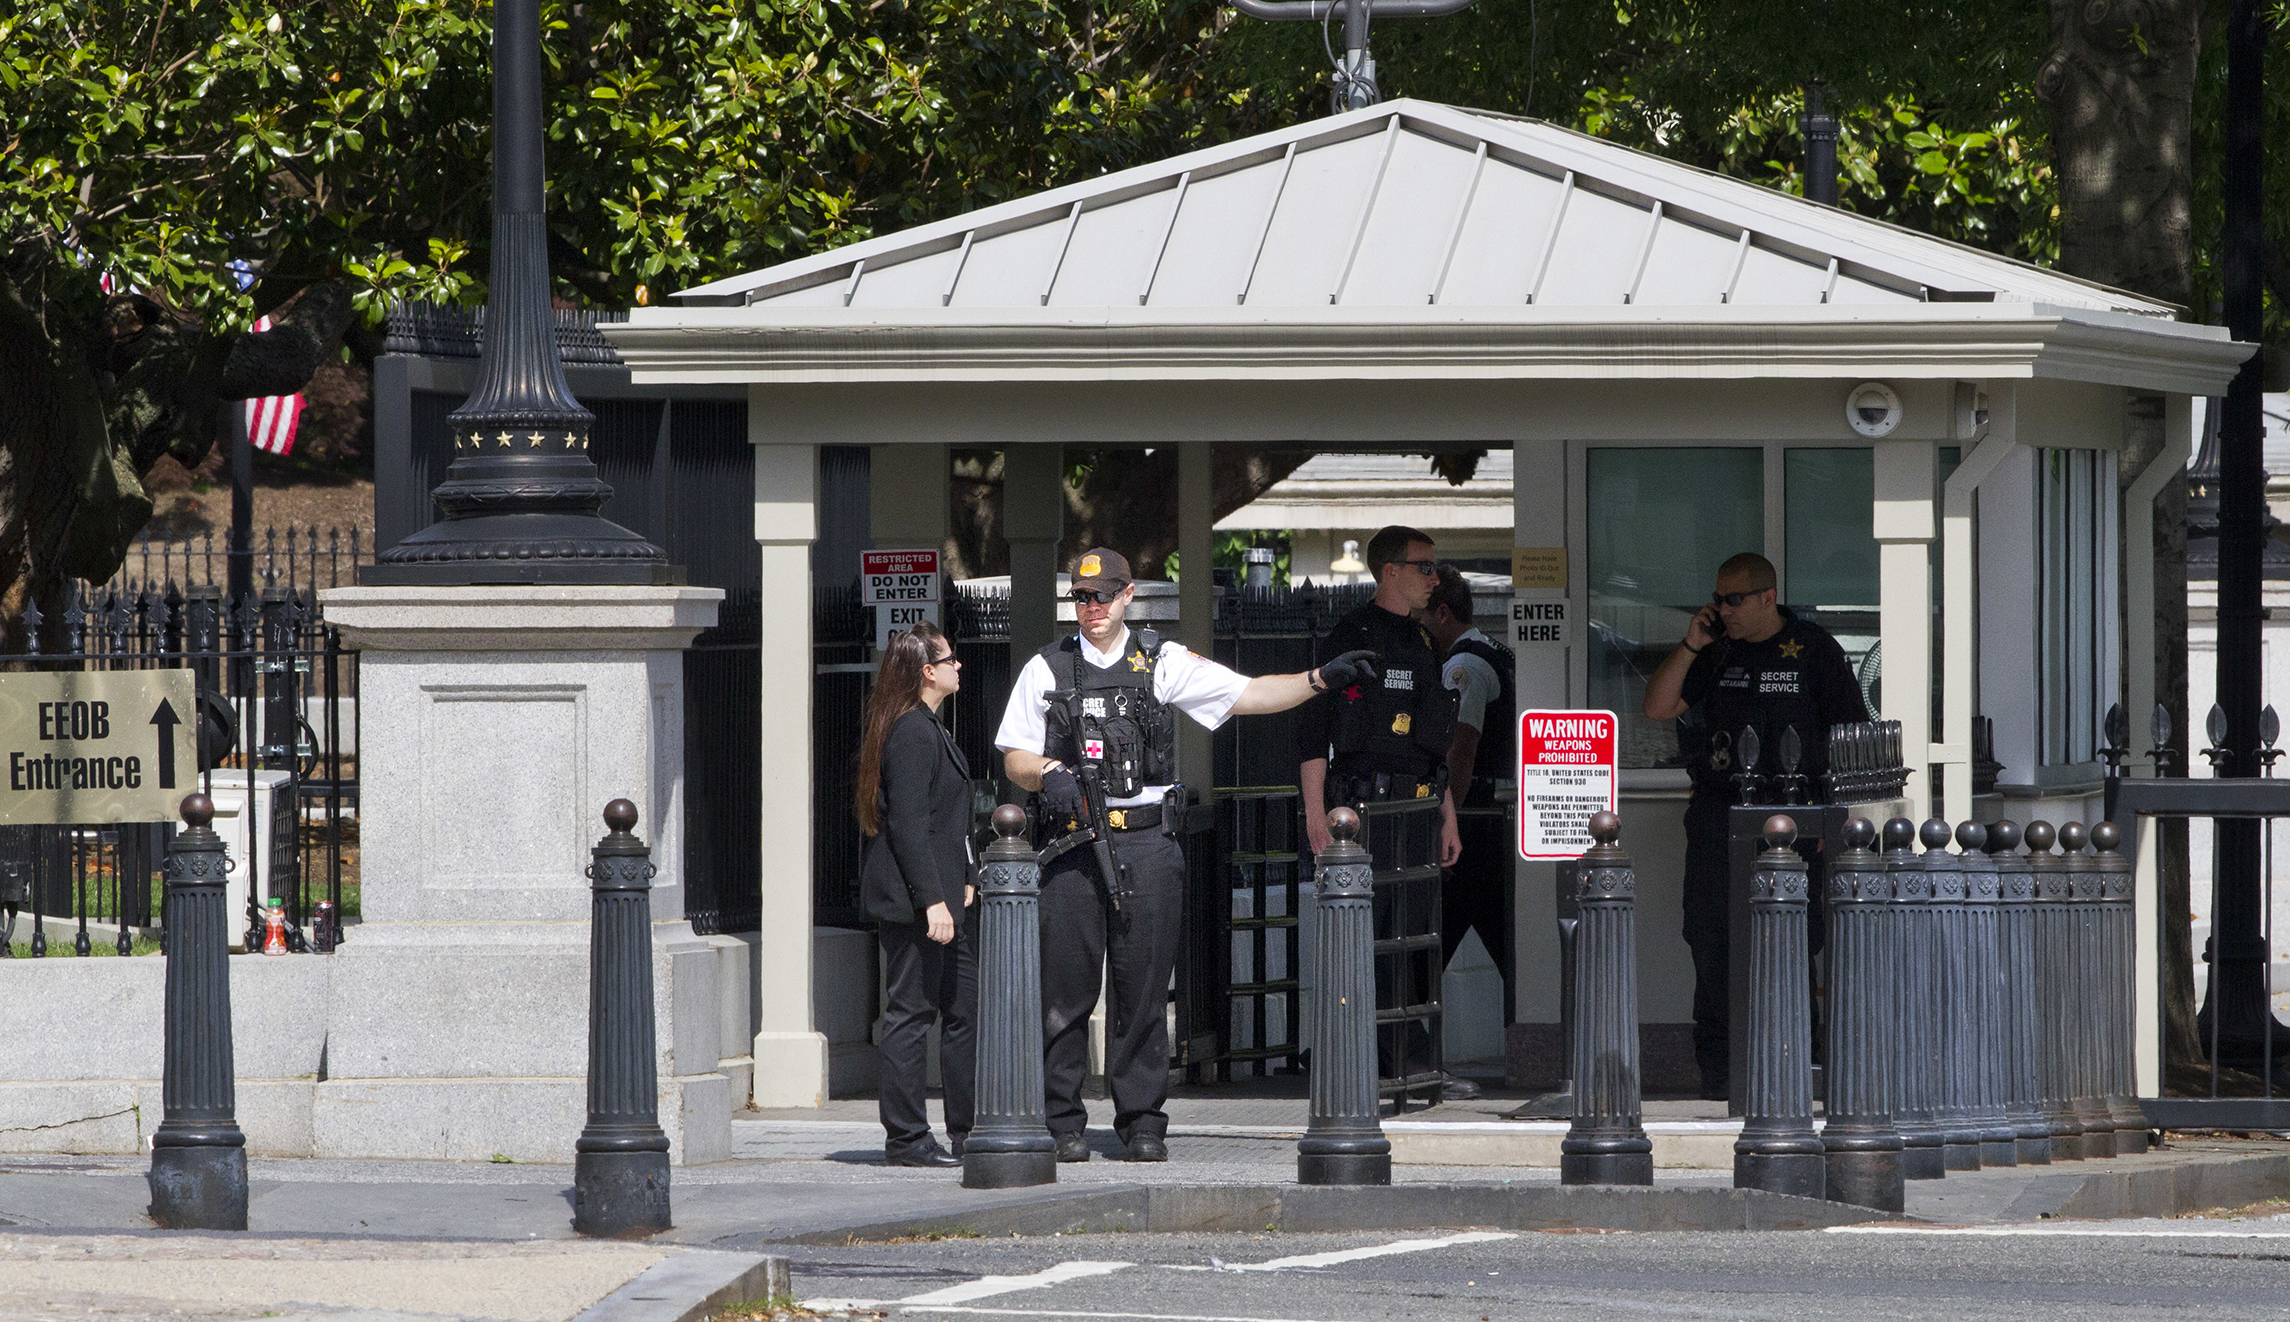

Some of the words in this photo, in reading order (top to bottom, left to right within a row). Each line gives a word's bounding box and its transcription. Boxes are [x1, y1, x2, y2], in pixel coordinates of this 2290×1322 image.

[868, 554, 932, 564] RESTRICTED
[887, 564, 914, 572] AREA
[1519, 564, 1538, 572] Photo
[872, 576, 894, 587] DO
[898, 575, 931, 587] NOT
[876, 588, 928, 600] ENTER
[891, 608, 925, 624] EXIT
[1513, 604, 1565, 620] ENTER
[1518, 625, 1560, 641] HERE
[1386, 669, 1413, 680] SECRET
[1760, 672, 1799, 681] SECRET
[1384, 679, 1414, 690] SERVICE
[1759, 683, 1799, 693] SERVICE
[1082, 697, 1105, 708] CRET
[39, 701, 110, 741] EEOB
[1529, 718, 1608, 739] WARNING
[1544, 740, 1592, 751] WEAPONS
[1538, 752, 1598, 763] PROHIBITED
[10, 752, 142, 791] Entrance
[1551, 769, 1572, 777] UNITED
[1572, 769, 1593, 777] STATES
[1594, 769, 1610, 777] CODE
[1549, 778, 1573, 786] SECTION
[1574, 778, 1587, 786] 930
[1574, 795, 1609, 803] DANGEROUS
[1532, 803, 1560, 811] WEAPONS
[1539, 820, 1570, 828] VIOLATORS
